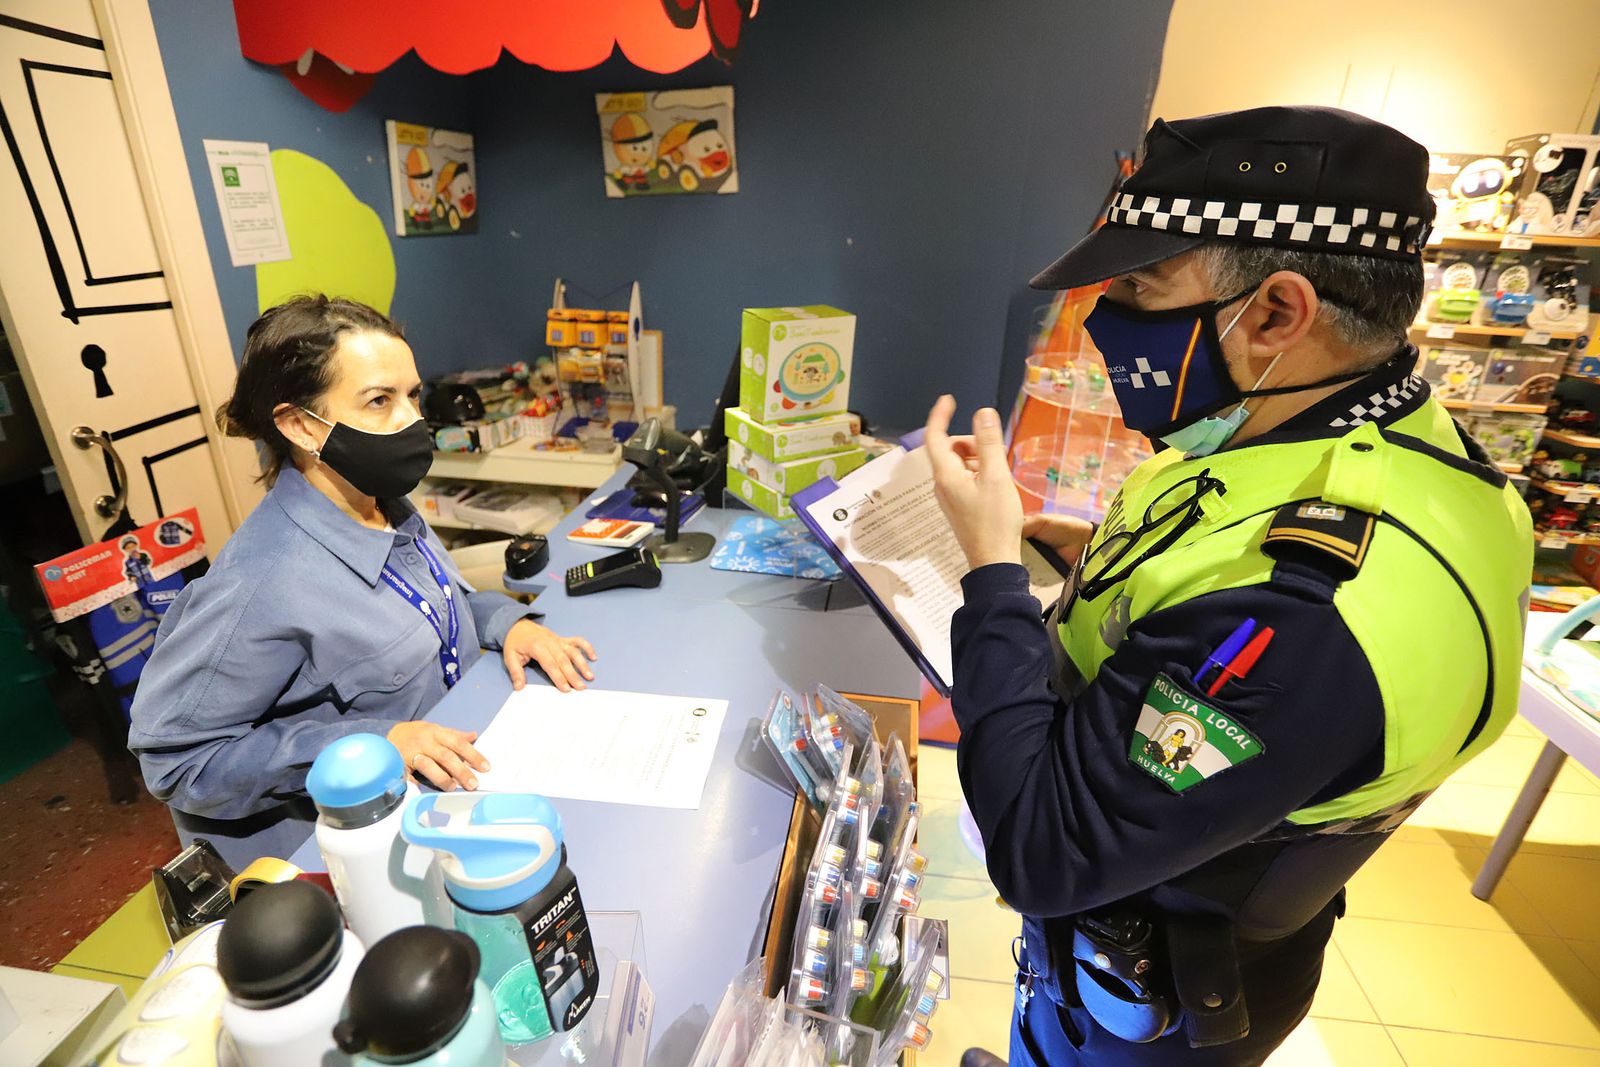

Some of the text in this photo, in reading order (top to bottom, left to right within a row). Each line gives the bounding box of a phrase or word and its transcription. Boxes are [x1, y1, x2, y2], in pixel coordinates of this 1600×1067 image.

[66, 569, 87, 583] SUIT
[1154, 679, 1251, 750] POLICIA LOCAL
[1137, 755, 1176, 783] HUELVA
